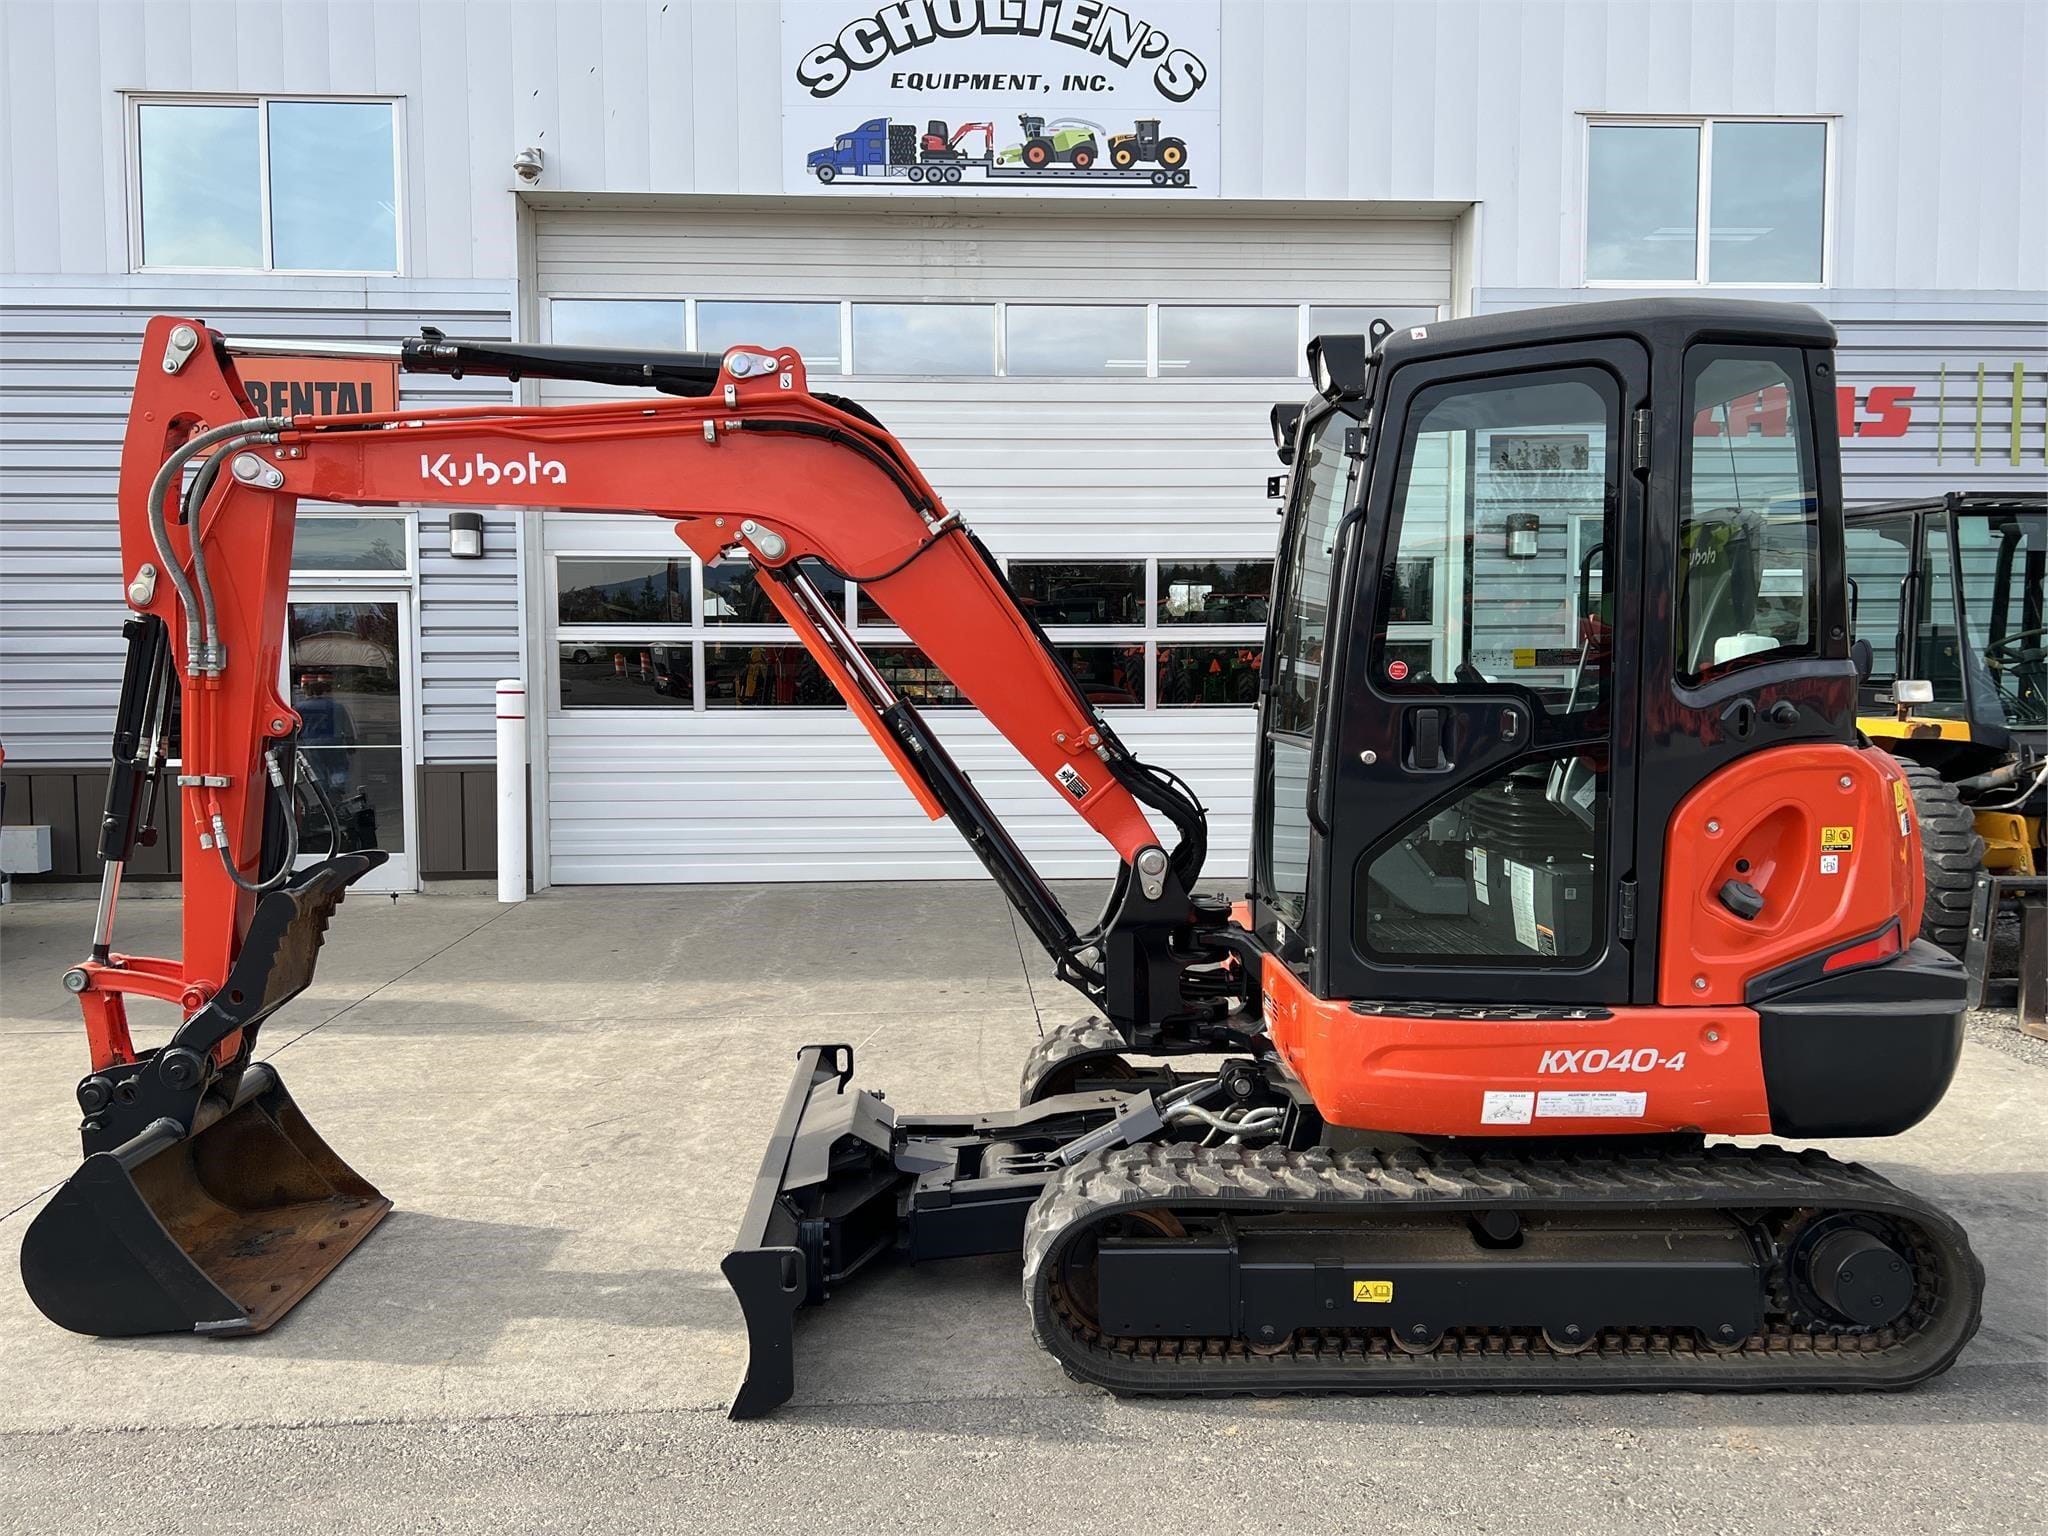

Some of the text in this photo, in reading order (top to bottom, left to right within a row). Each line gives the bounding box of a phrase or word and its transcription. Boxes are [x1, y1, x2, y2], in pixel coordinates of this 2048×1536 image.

[797, 0, 1207, 103] SCHOLTEN'S
[890, 72, 1116, 94] EQUIPMENT, INC.
[420, 452, 567, 486] Kubota
[1689, 546, 1716, 566] ubota
[1537, 1048, 1687, 1074] KX040-4
